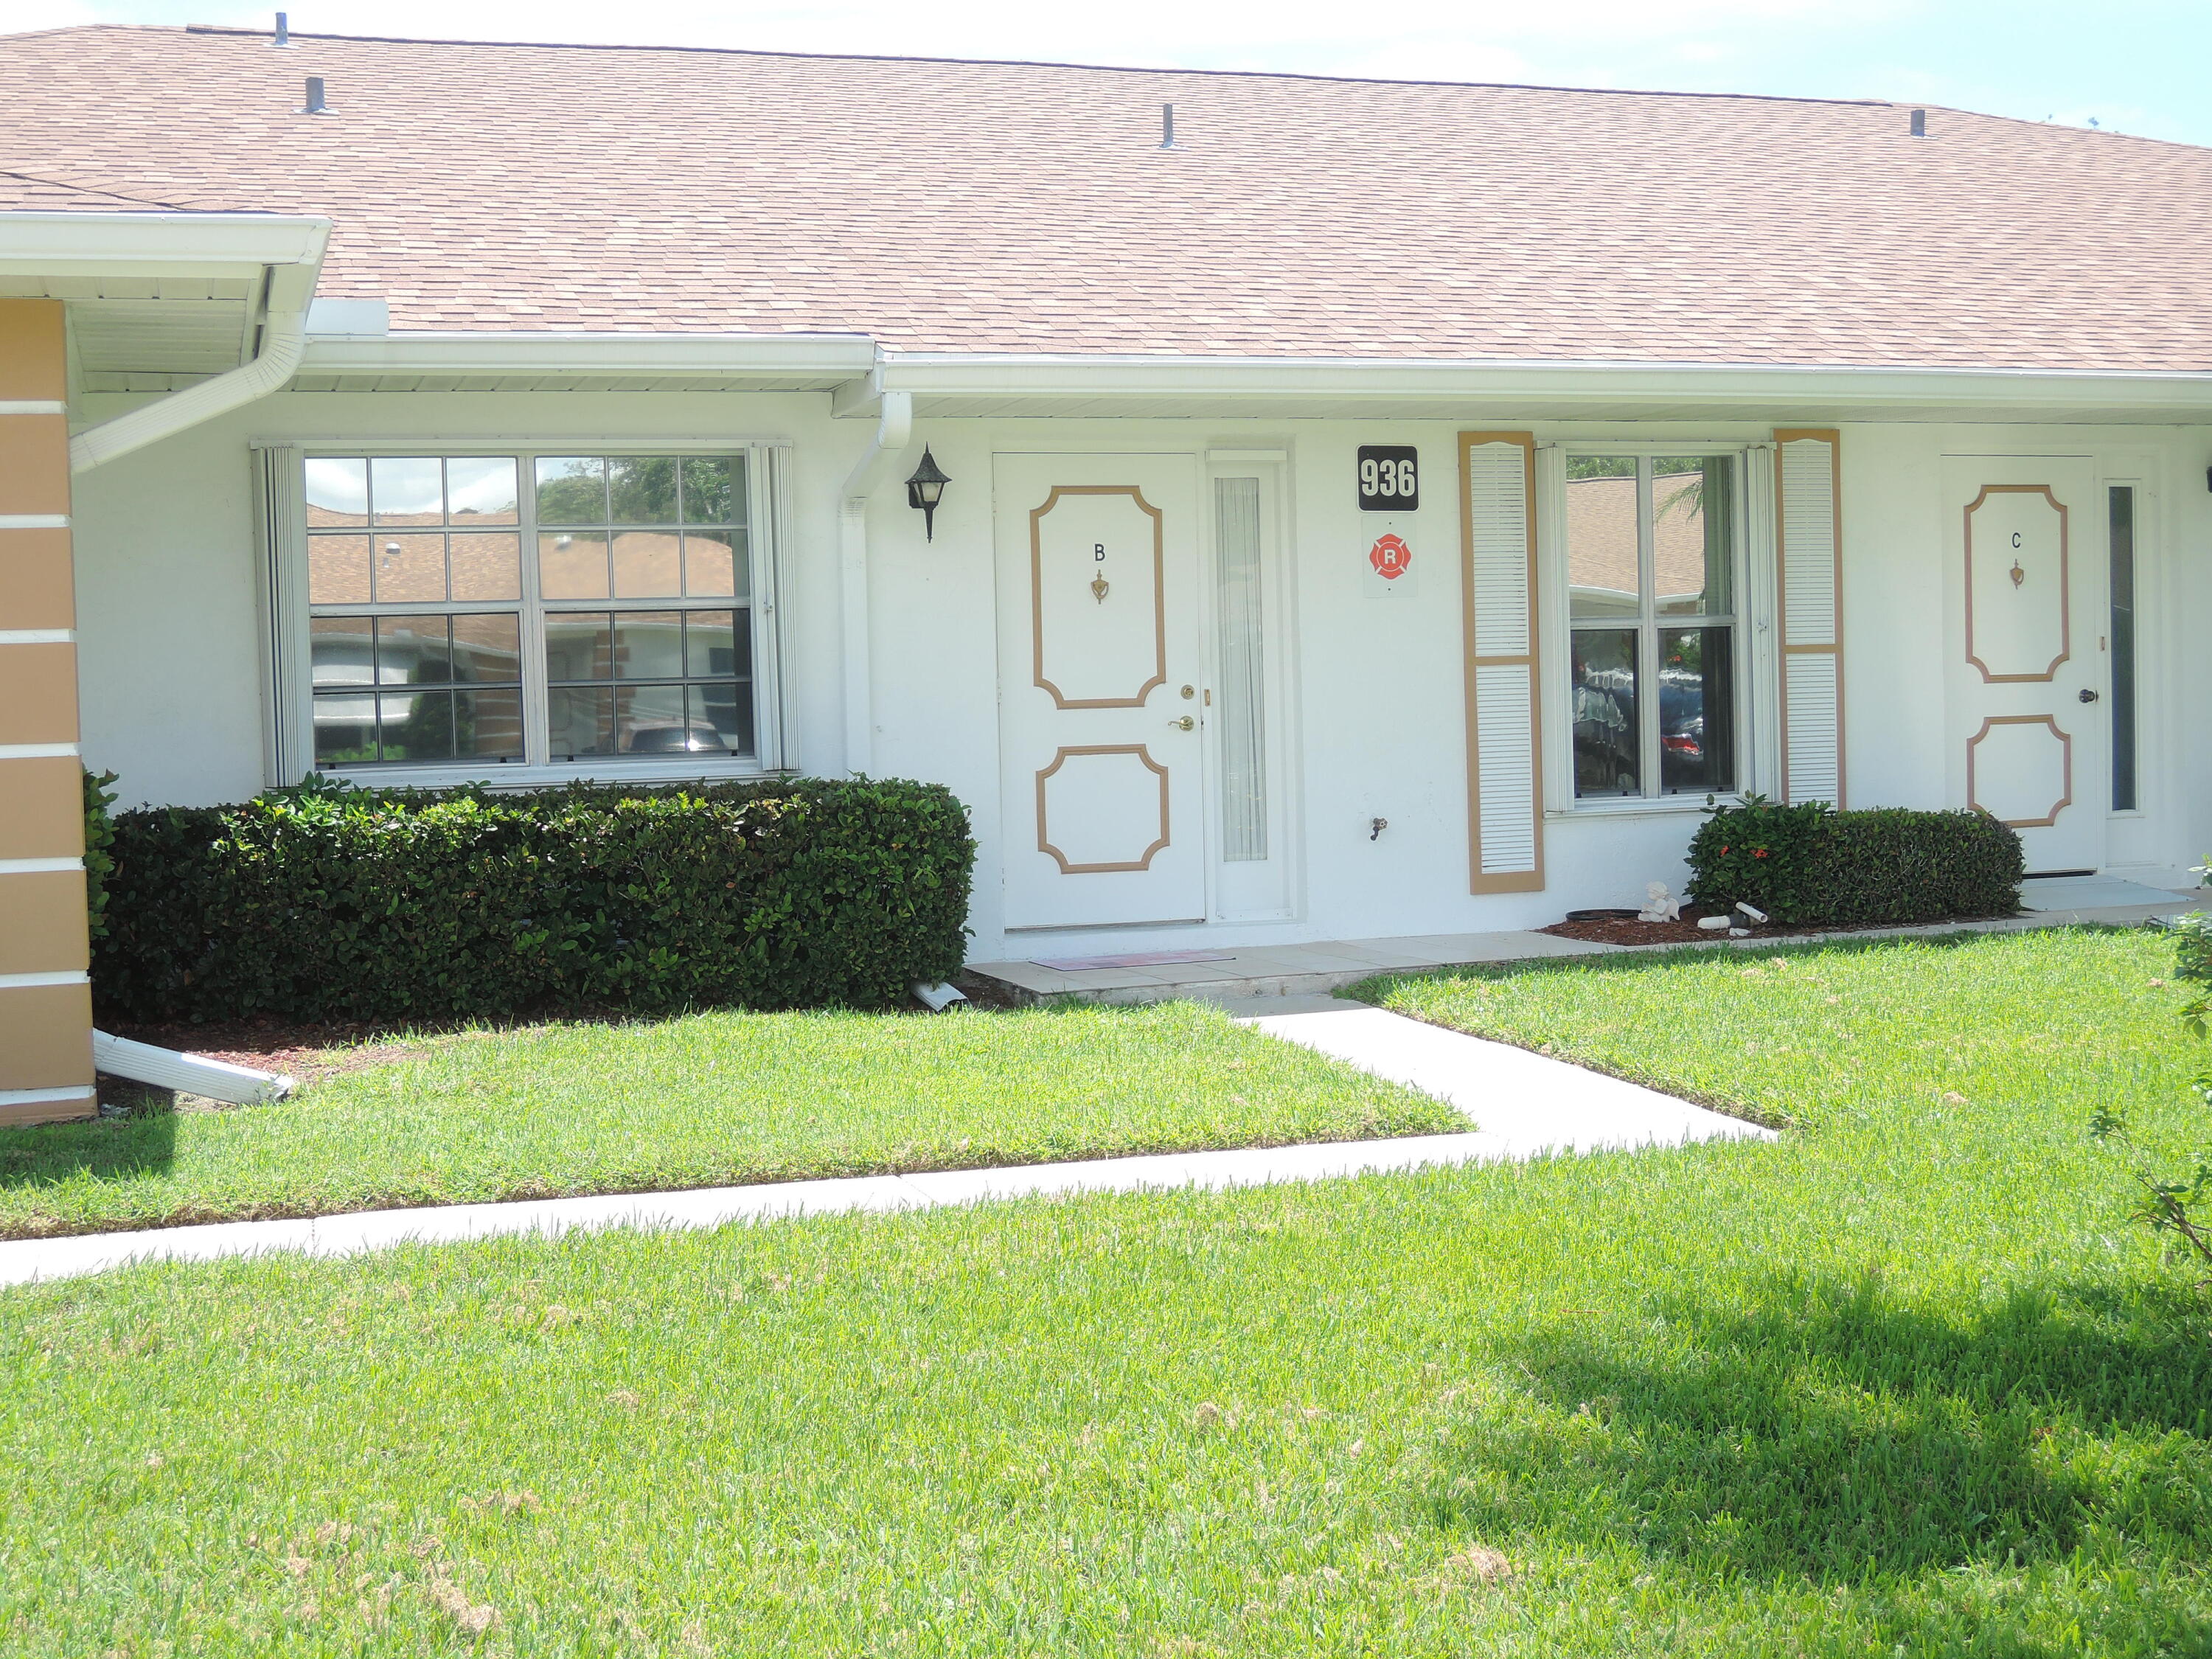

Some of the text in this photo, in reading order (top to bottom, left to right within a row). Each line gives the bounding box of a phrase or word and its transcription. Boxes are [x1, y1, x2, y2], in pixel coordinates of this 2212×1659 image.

[1360, 459, 1416, 497] 936
[2011, 532, 2021, 549] C
[1094, 543, 1106, 562] B
[1384, 549, 1397, 565] R
